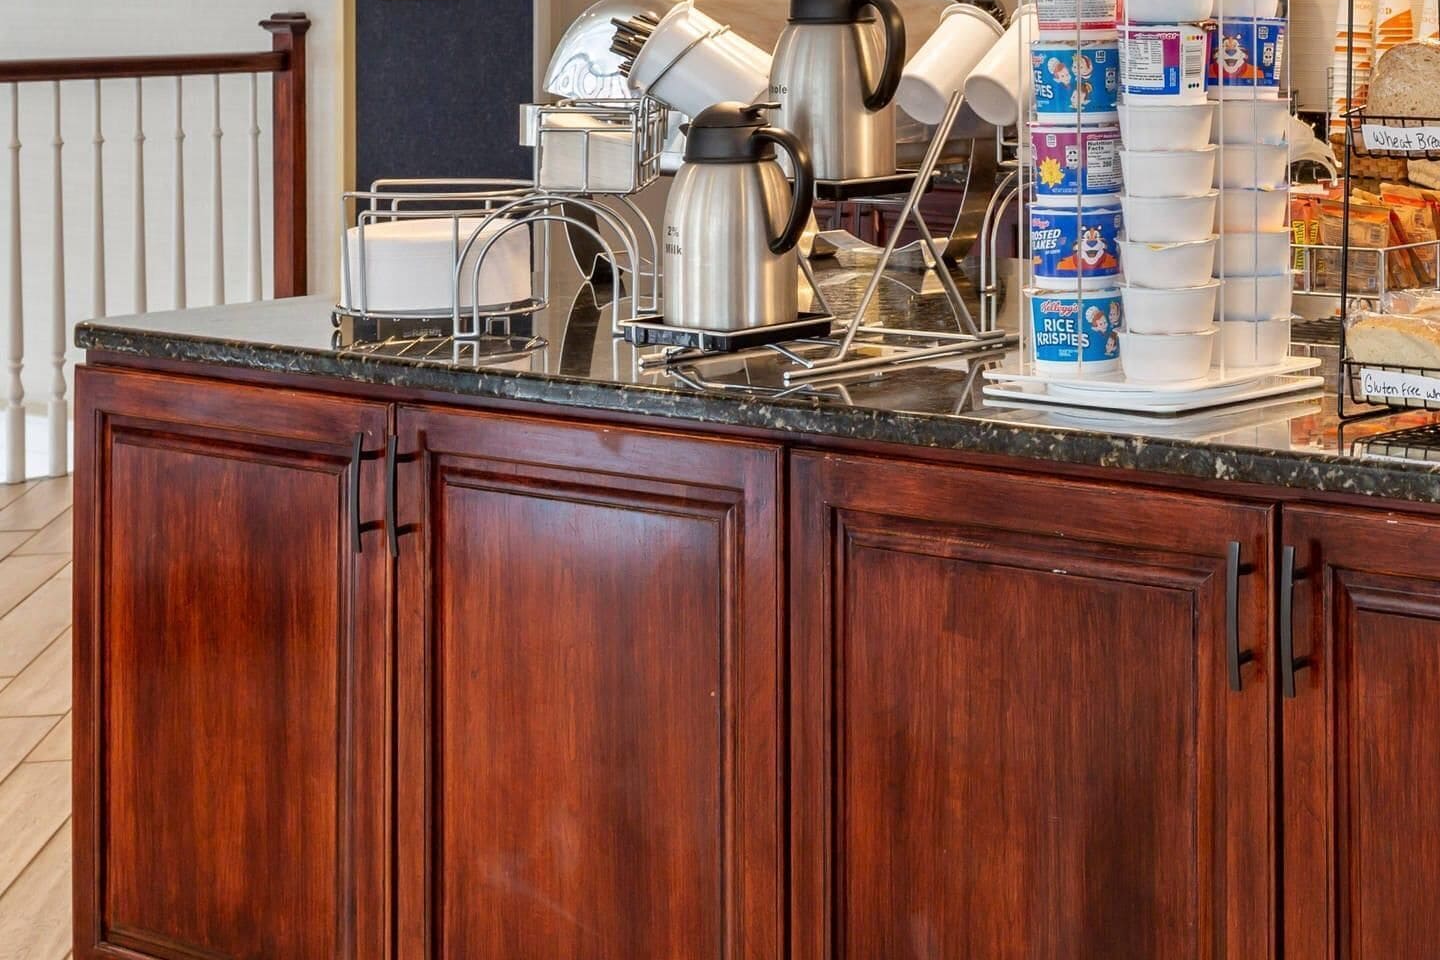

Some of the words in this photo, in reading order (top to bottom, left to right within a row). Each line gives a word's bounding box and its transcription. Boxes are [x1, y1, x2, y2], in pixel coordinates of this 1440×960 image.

[1373, 131, 1412, 149] Wheat
[667, 226, 679, 236] 2%
[666, 244, 682, 256] Milk
[1041, 300, 1079, 317] Kellogg's
[1044, 319, 1074, 332] RICE
[1037, 332, 1090, 348] KRISPIES
[1364, 373, 1399, 394] Gluten
